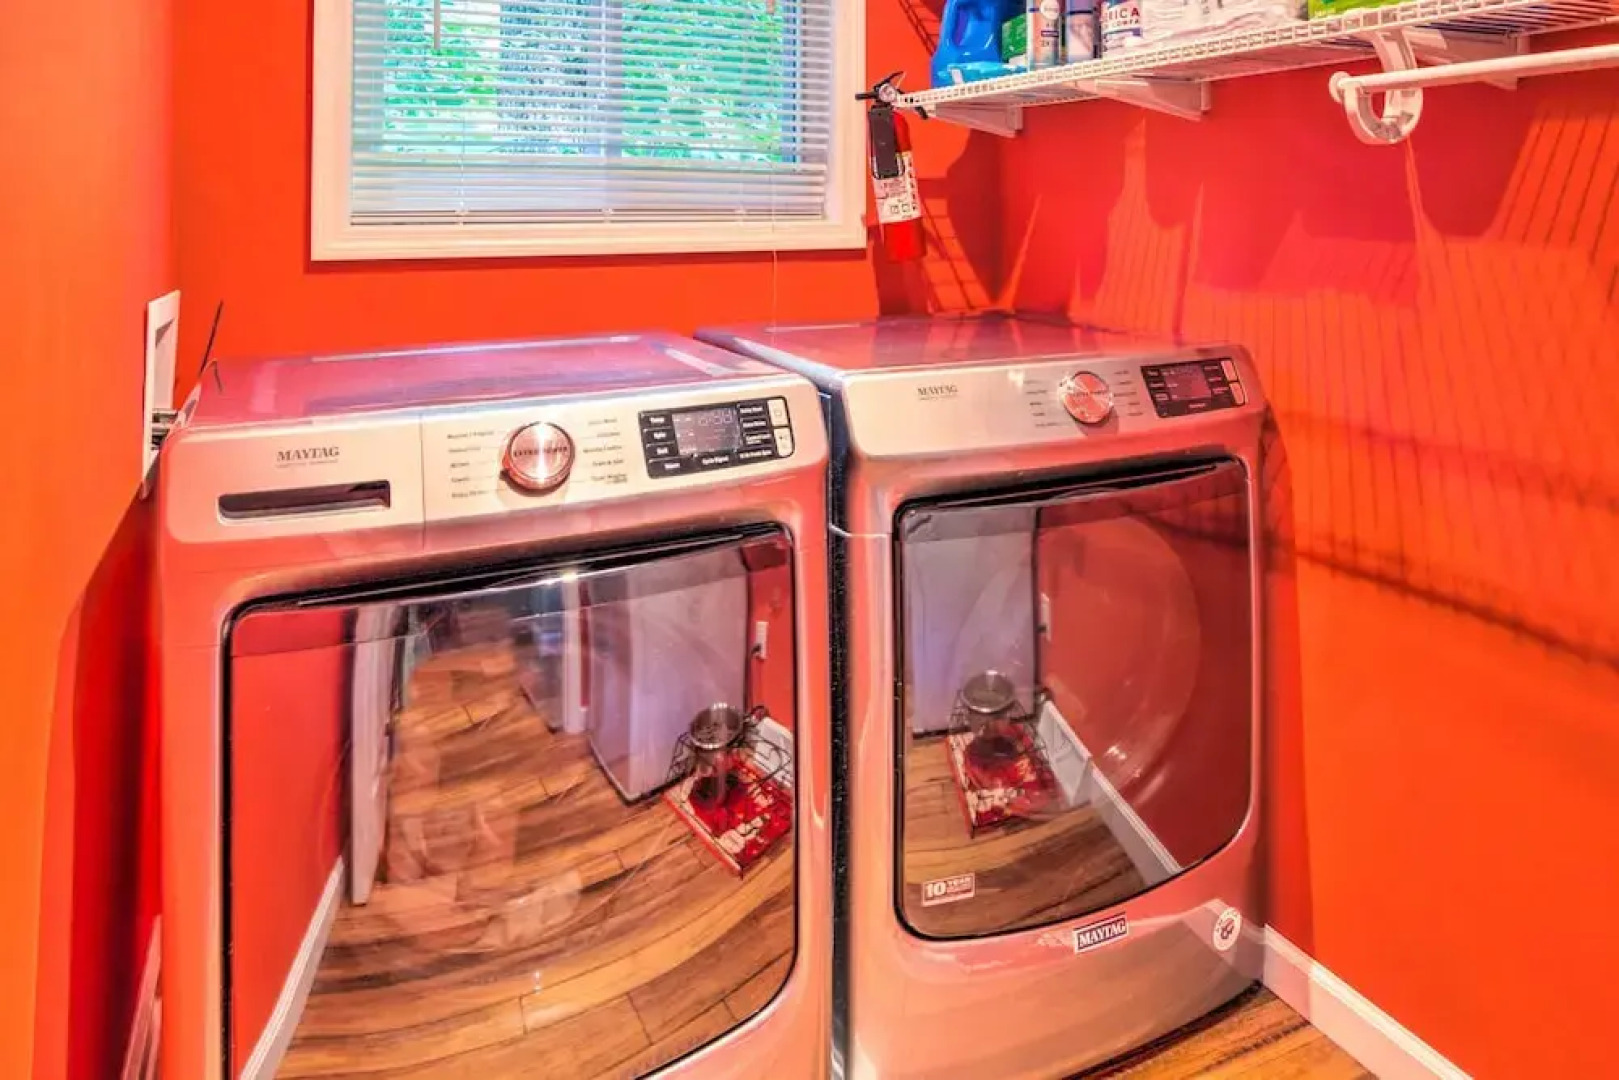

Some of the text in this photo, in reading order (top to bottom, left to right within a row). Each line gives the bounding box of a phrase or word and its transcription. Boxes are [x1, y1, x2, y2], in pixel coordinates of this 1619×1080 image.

[276, 446, 341, 463] MAYTAG
[925, 881, 947, 898] 10
[1079, 919, 1127, 948] MAYTAG
